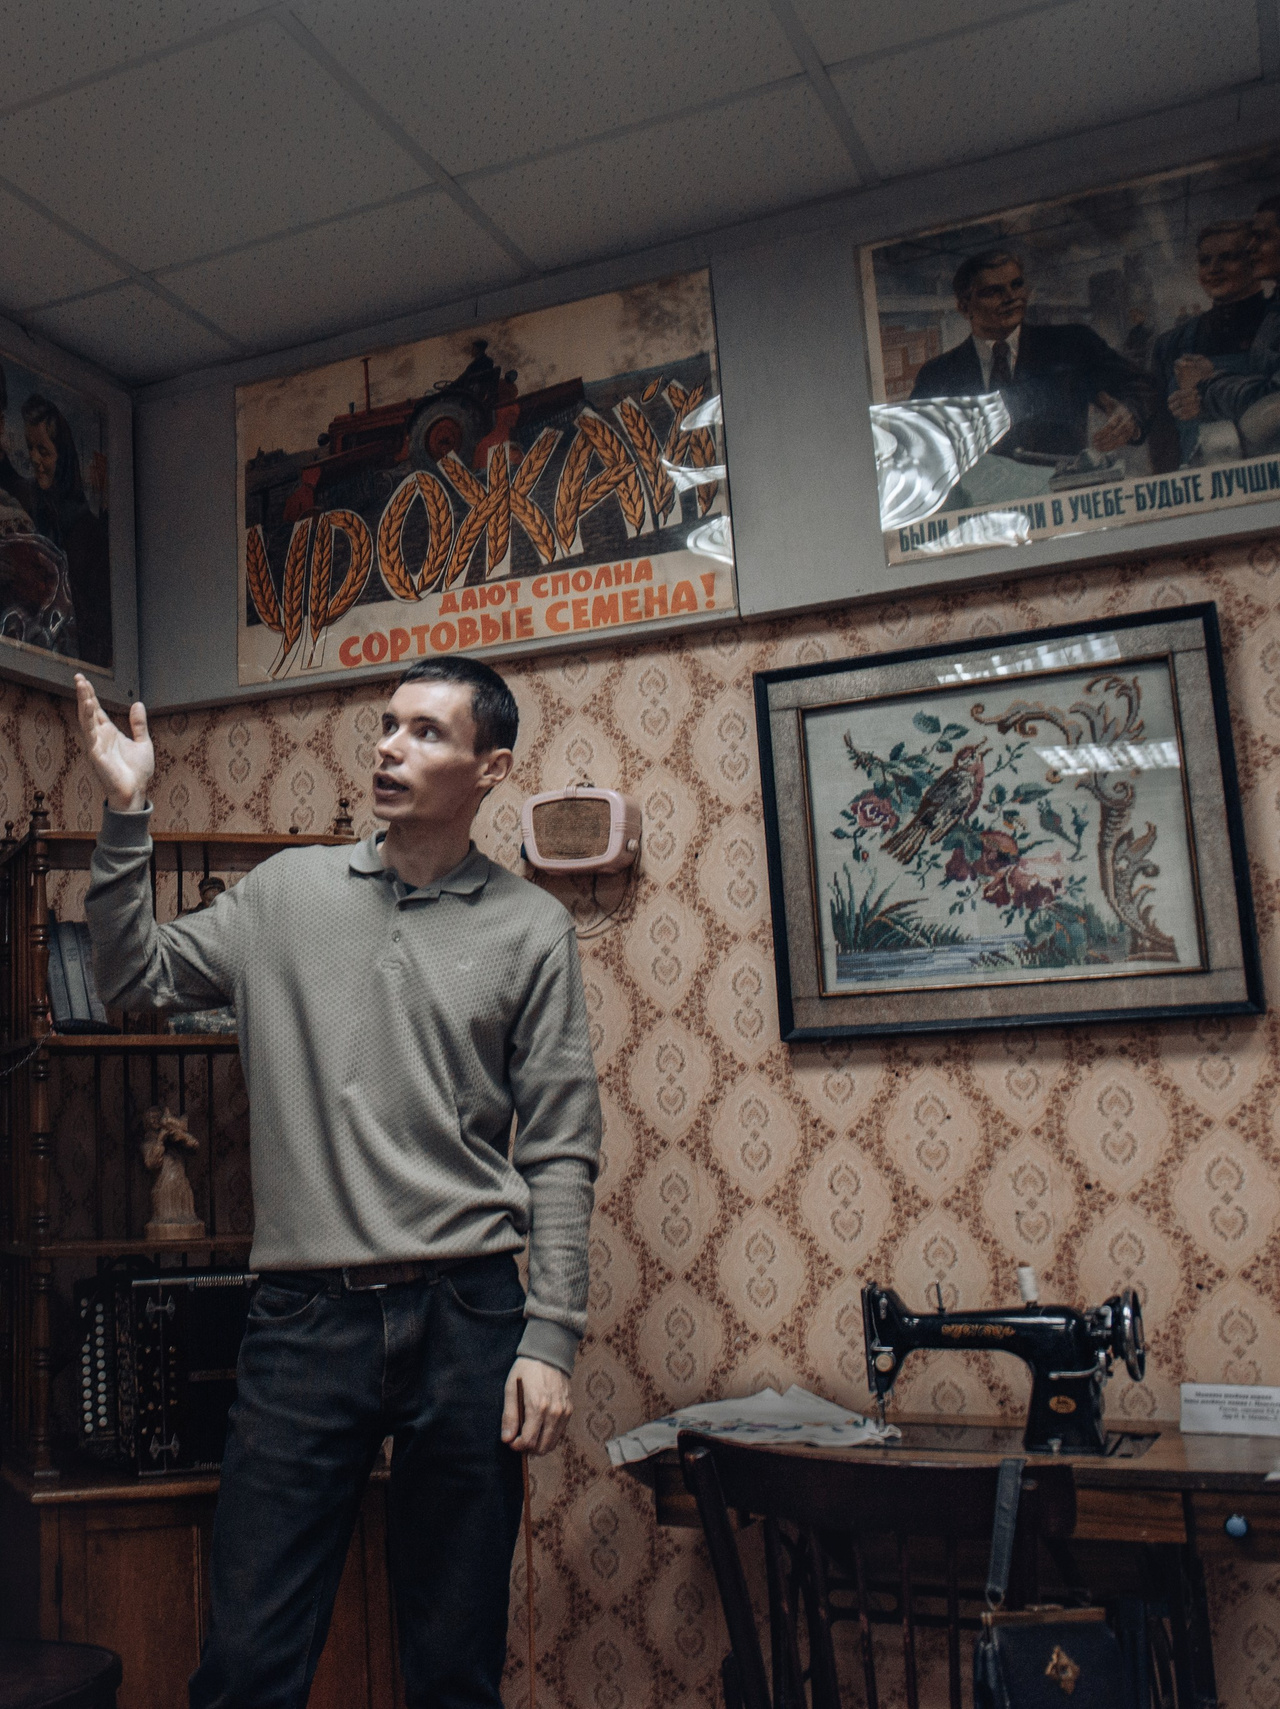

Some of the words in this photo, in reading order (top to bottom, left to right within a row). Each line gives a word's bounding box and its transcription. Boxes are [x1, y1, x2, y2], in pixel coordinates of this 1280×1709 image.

[246, 374, 718, 677] УРОЖАЙ
[899, 518, 948, 552] БЫЛИ
[1051, 499, 1064, 526] В
[338, 606, 534, 667] СОРТОВЫЕ
[544, 572, 717, 633] СЕМЕНА!
[439, 581, 520, 616] ДАЮТ
[531, 558, 653, 599] СПОЛНА
